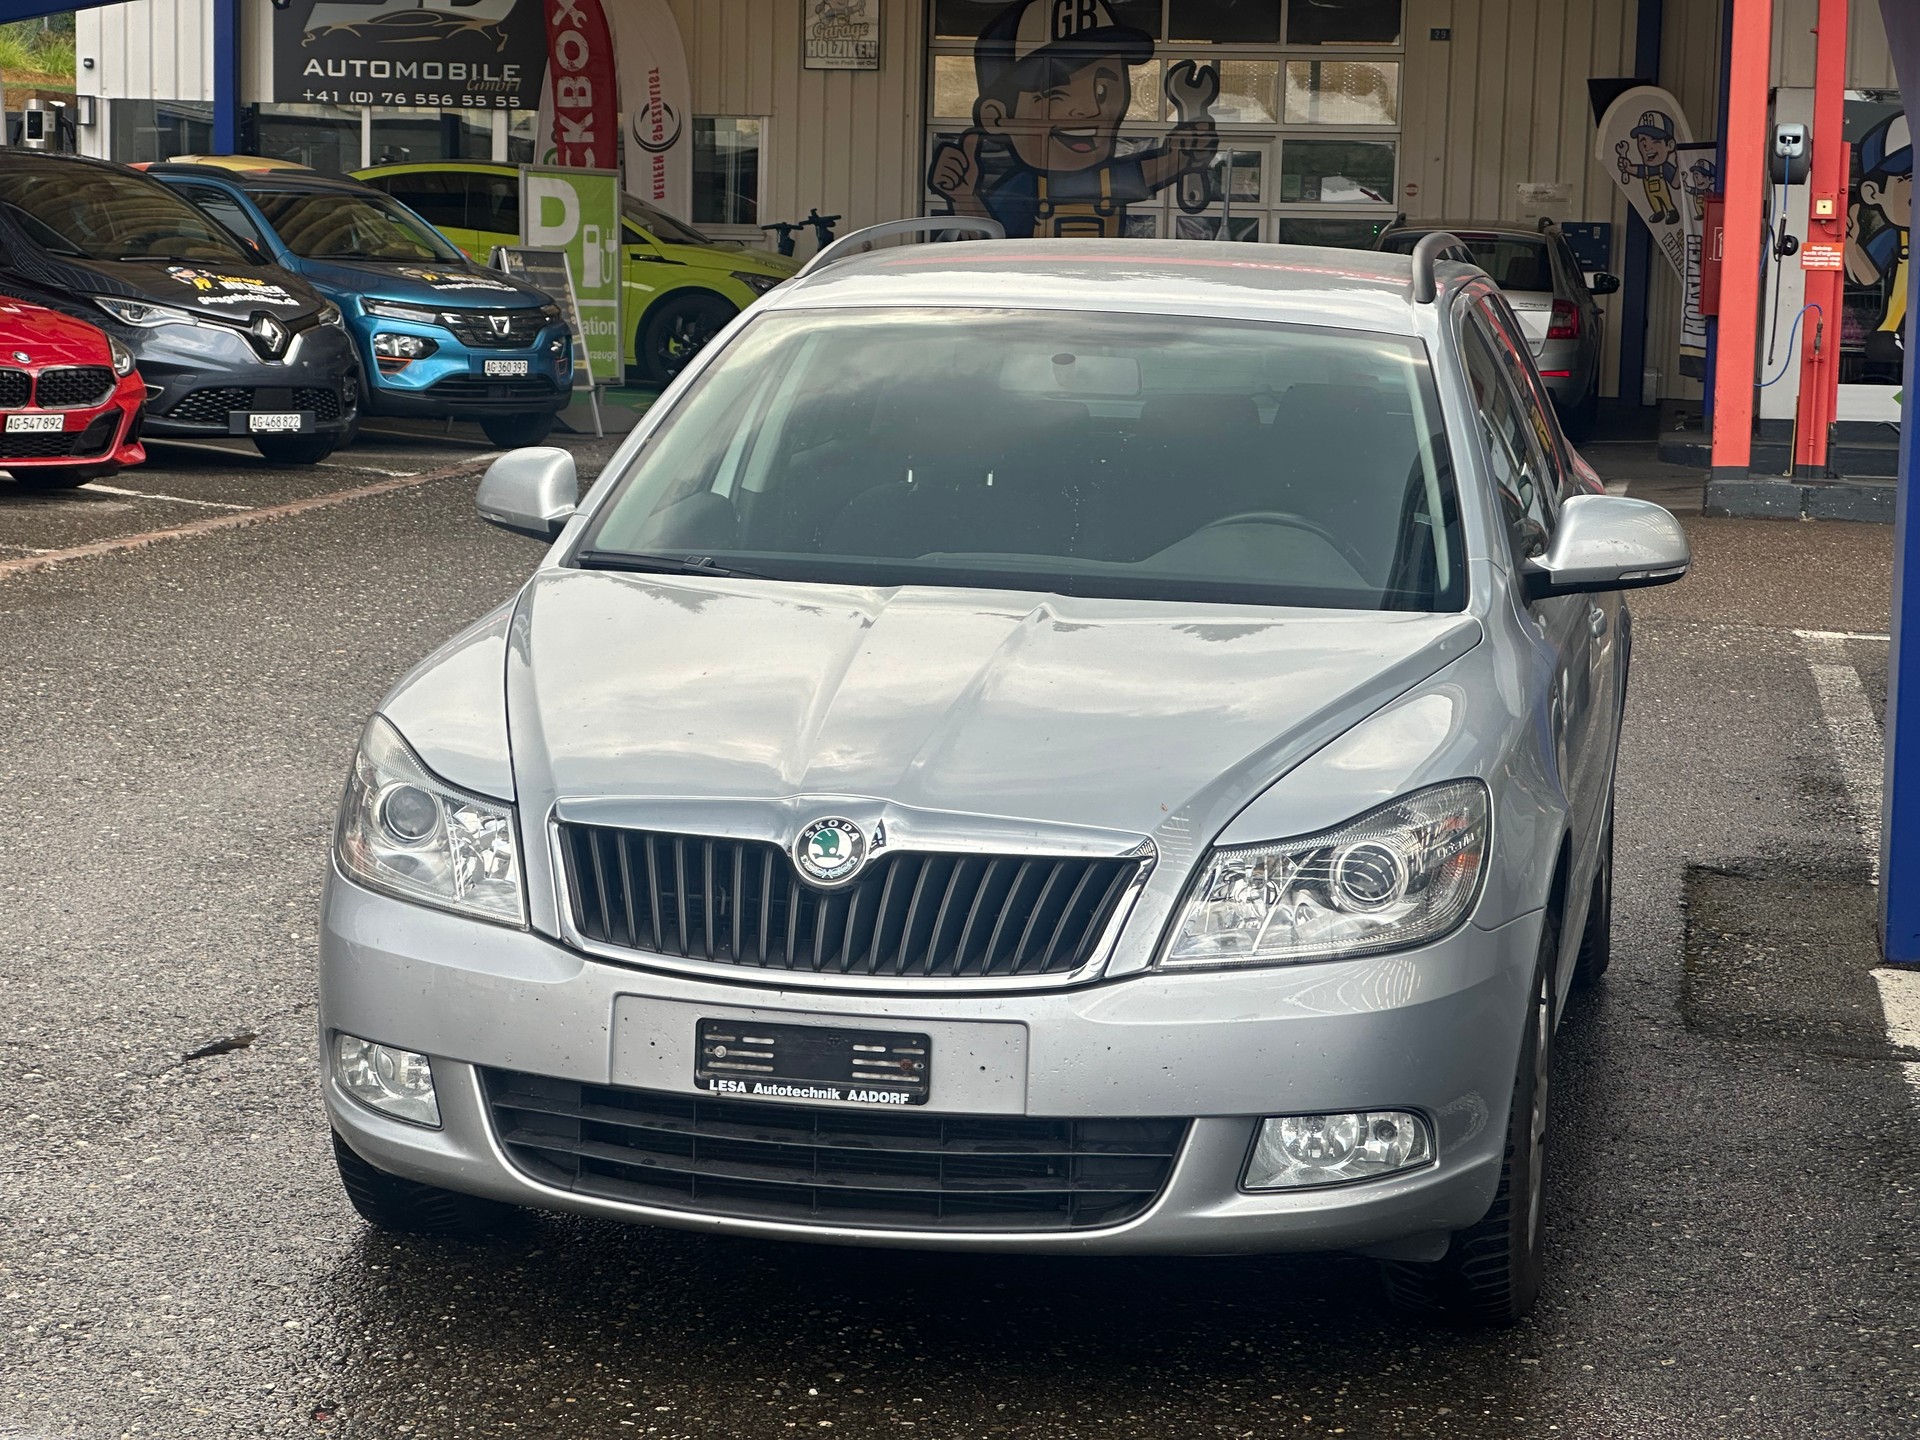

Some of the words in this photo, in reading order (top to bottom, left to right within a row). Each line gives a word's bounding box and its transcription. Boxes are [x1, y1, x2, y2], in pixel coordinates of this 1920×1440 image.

[812, 22, 870, 41] Garage
[806, 39, 877, 59] HOLZIKEN
[303, 58, 521, 82] AUTOMOBILE
[466, 76, 522, 92] GmbH
[303, 89, 338, 102] +41
[381, 92, 406, 104] 76
[415, 93, 453, 106] 556
[462, 94, 487, 106] 55
[495, 95, 520, 107] 55
[582, 316, 617, 335] ation
[589, 350, 618, 361] rzeuge
[709, 1079, 747, 1093] LESA
[753, 1082, 841, 1100] Autotechnik
[847, 1089, 910, 1105] AADORF
